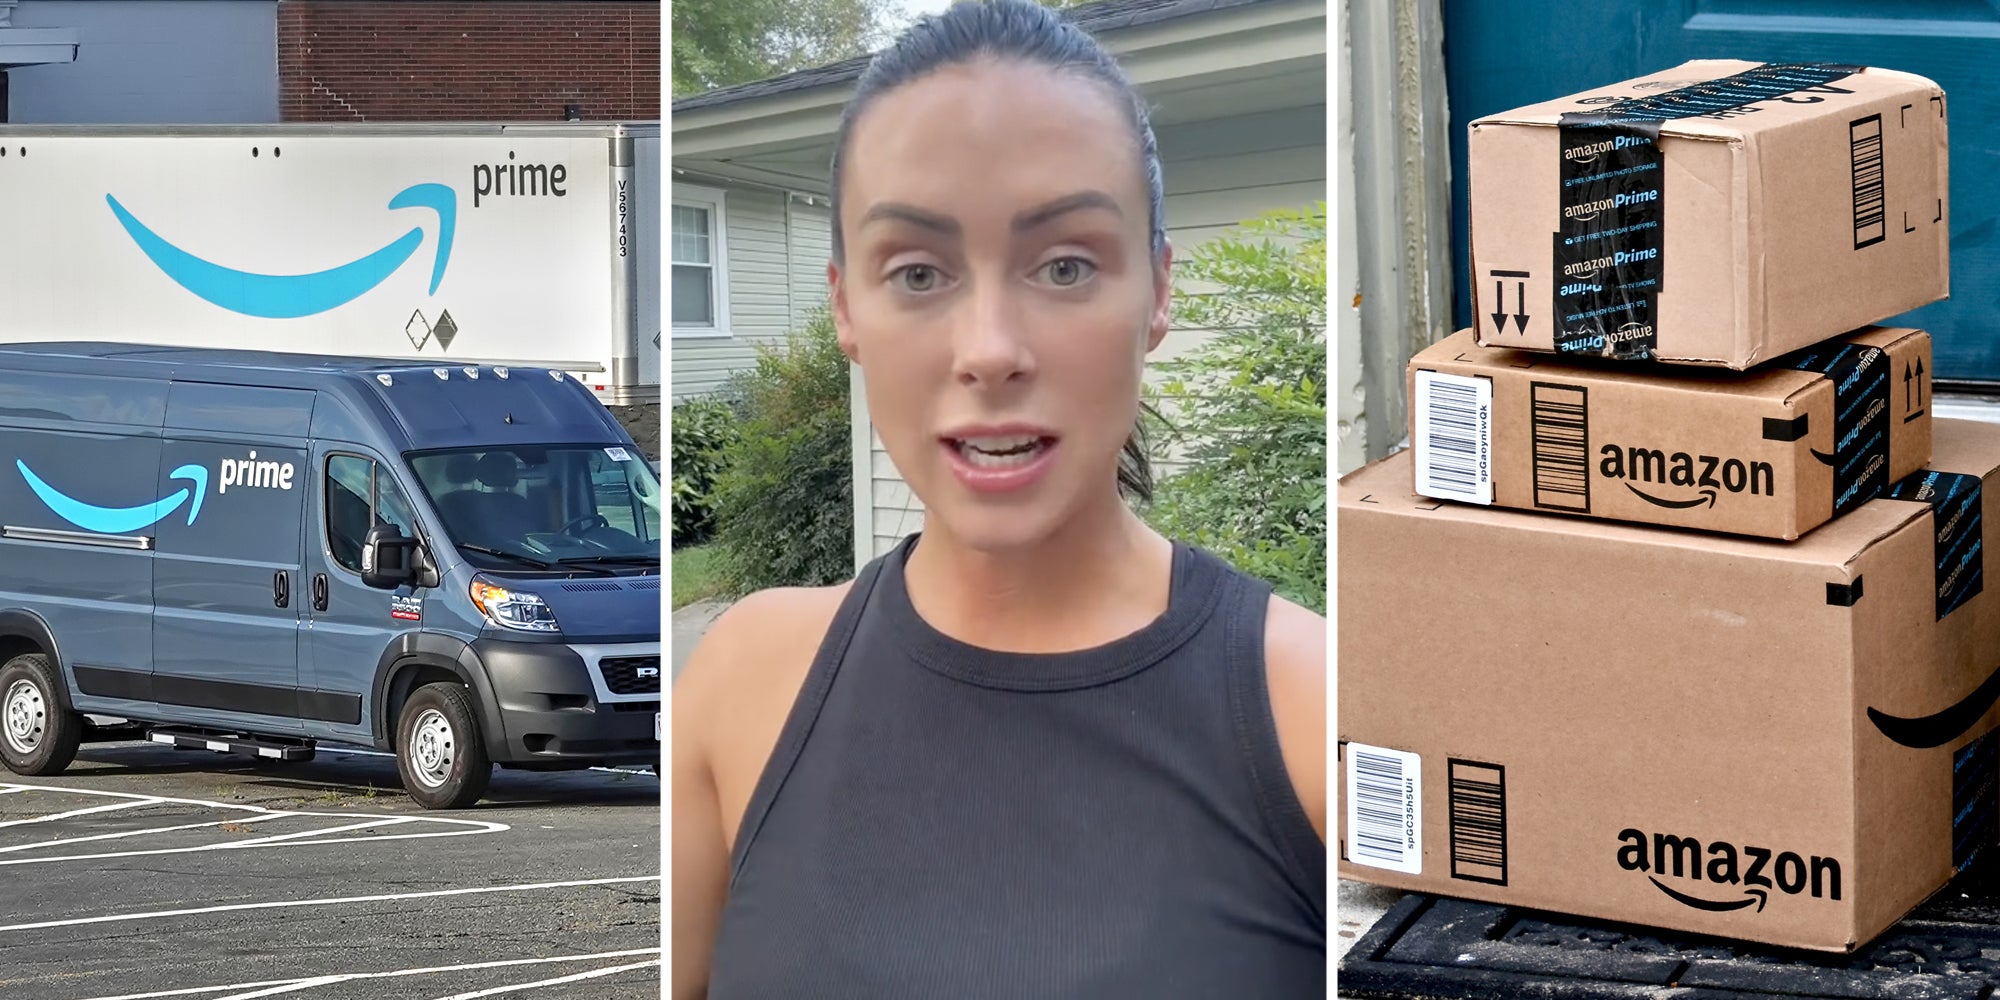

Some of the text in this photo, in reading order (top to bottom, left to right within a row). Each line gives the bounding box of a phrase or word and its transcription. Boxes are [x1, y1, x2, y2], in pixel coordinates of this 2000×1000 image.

[474, 151, 567, 208] prime
[618, 180, 628, 257] V567403
[219, 451, 294, 493] prime
[1479, 404, 1488, 483] spGaoyniwQk
[1600, 443, 1774, 496] amazon
[1406, 777, 1416, 850] spGC35h5Uit
[1617, 828, 1842, 901] amazon
